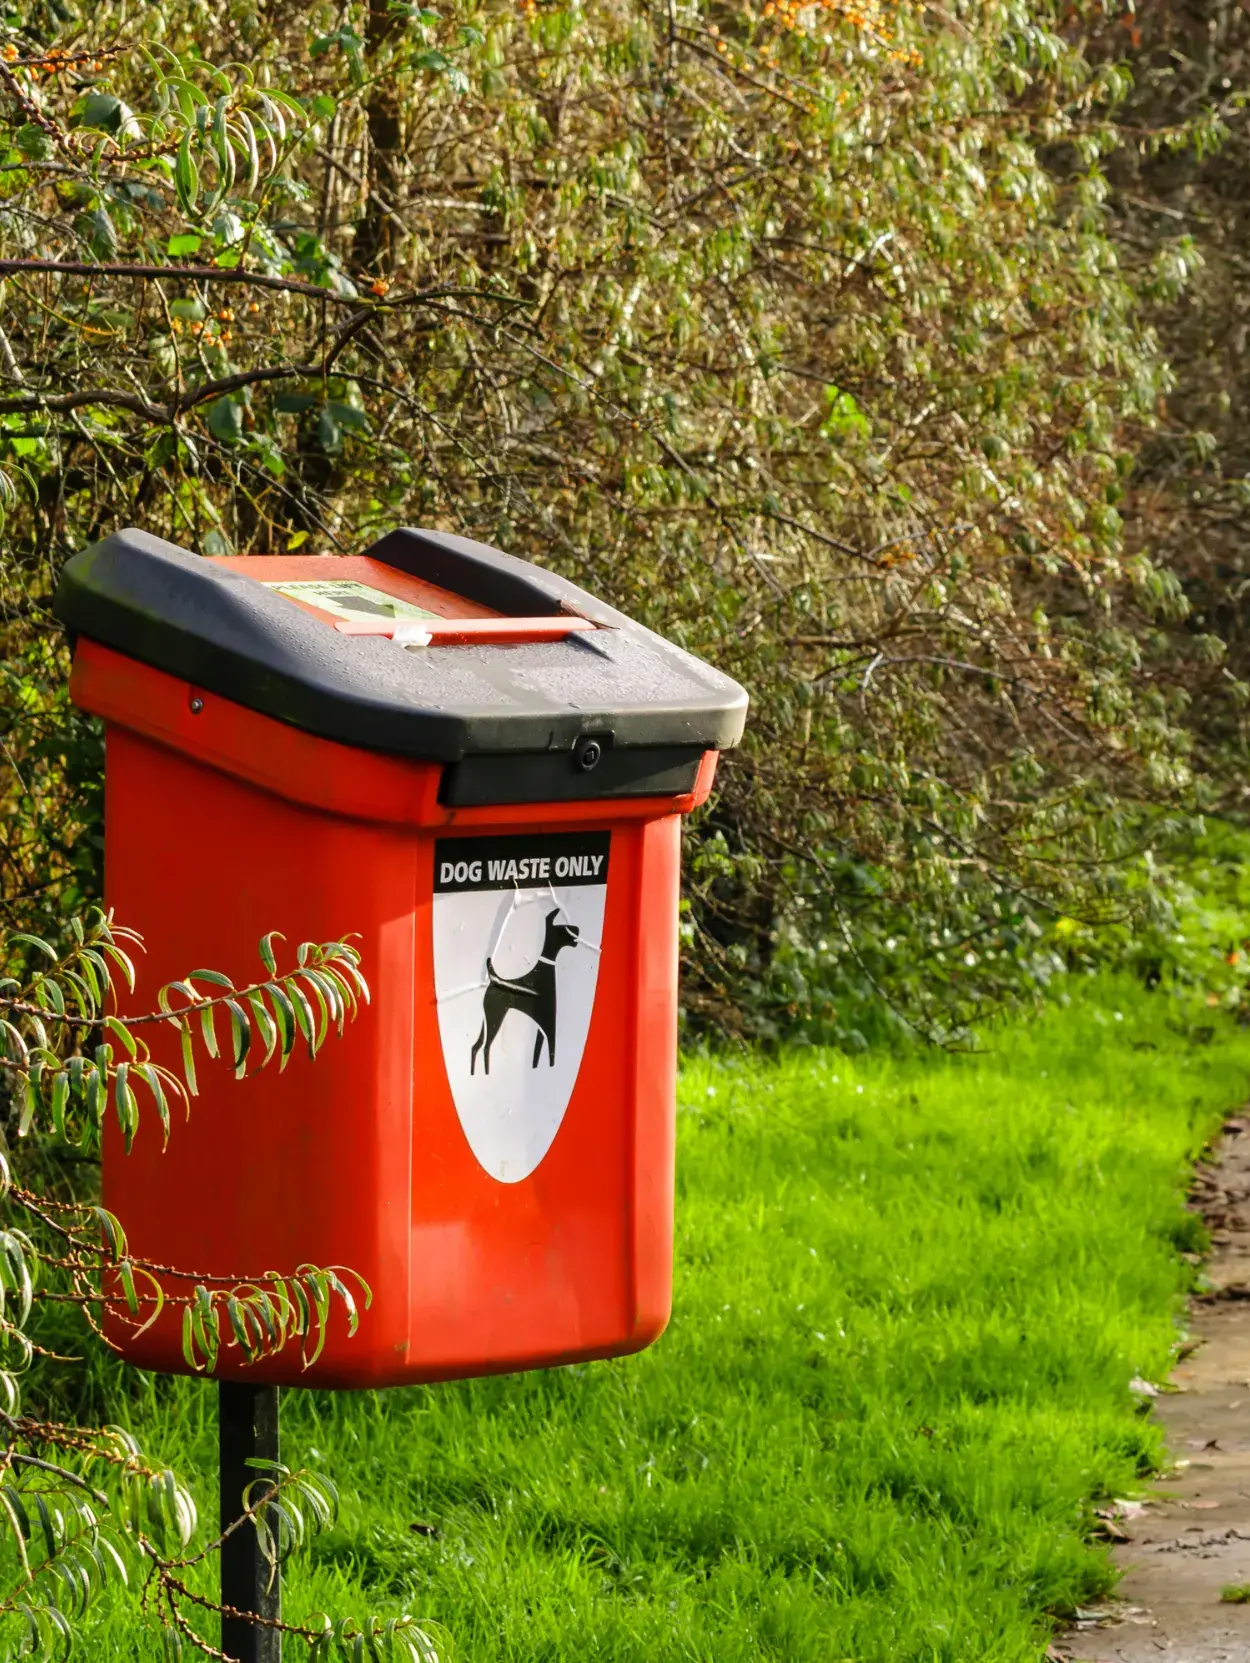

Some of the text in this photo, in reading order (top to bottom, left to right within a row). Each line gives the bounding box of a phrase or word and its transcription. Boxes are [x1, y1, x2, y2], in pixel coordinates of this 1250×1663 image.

[440, 855, 604, 884] DOG WASTE ONLY
